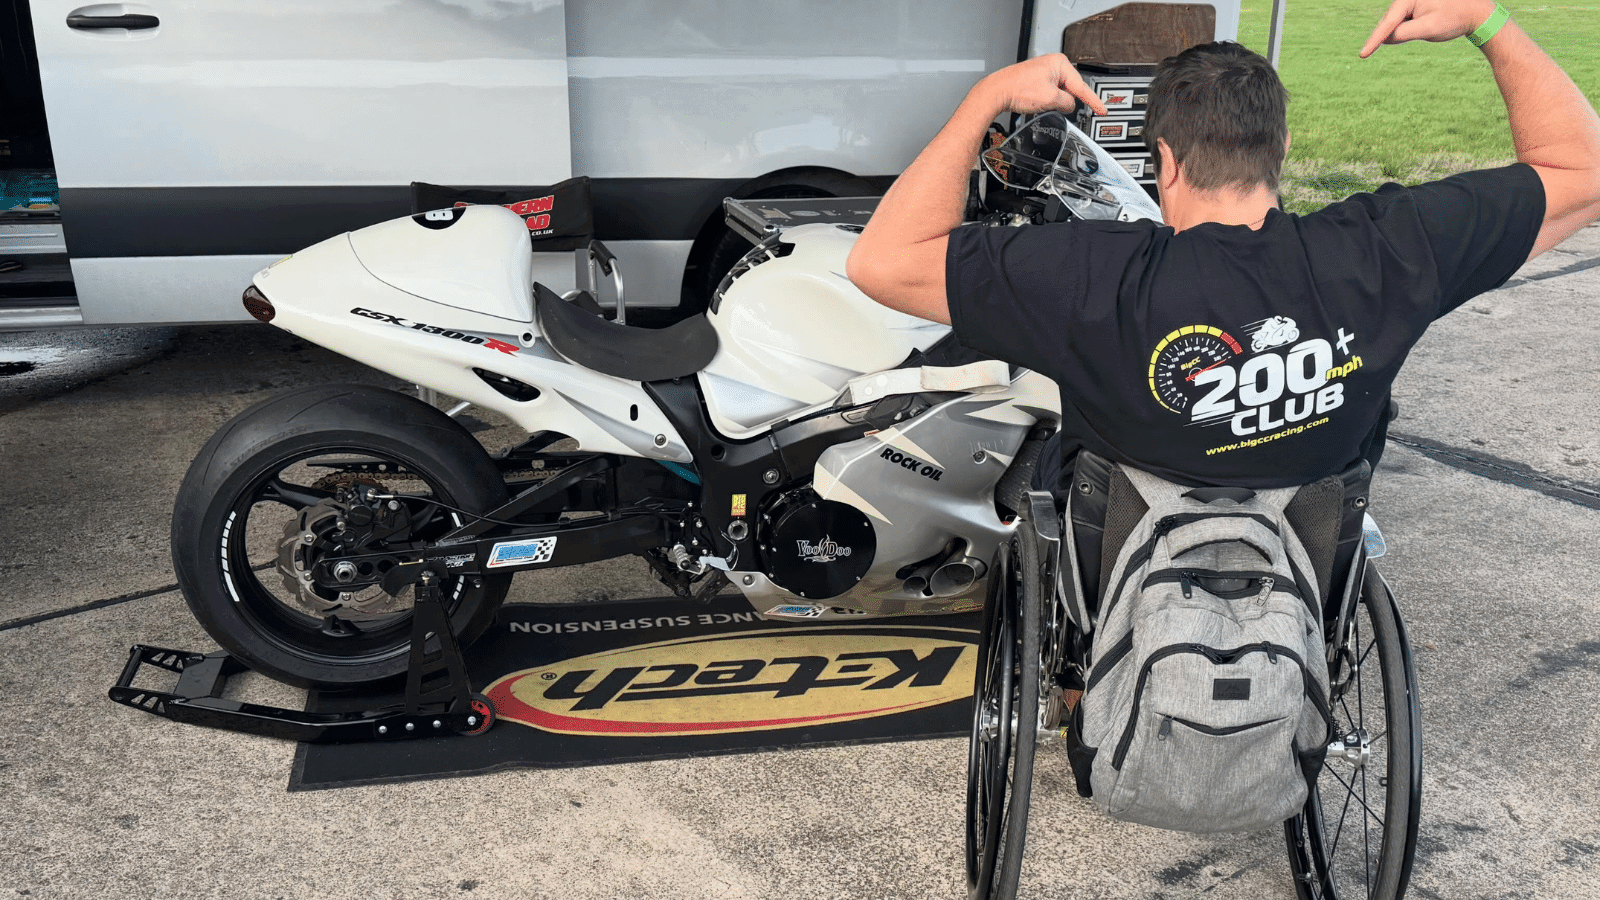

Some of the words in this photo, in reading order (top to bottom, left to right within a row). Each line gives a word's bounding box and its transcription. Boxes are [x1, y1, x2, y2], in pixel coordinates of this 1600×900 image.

[526, 214, 550, 230] AD
[1325, 354, 1363, 381] mph
[1231, 382, 1345, 436] CLUB
[1206, 417, 1329, 456] www.bigccracing.com
[880, 448, 922, 472] ROCK
[920, 466, 943, 481] OIL
[510, 615, 690, 634] SUSPENSION
